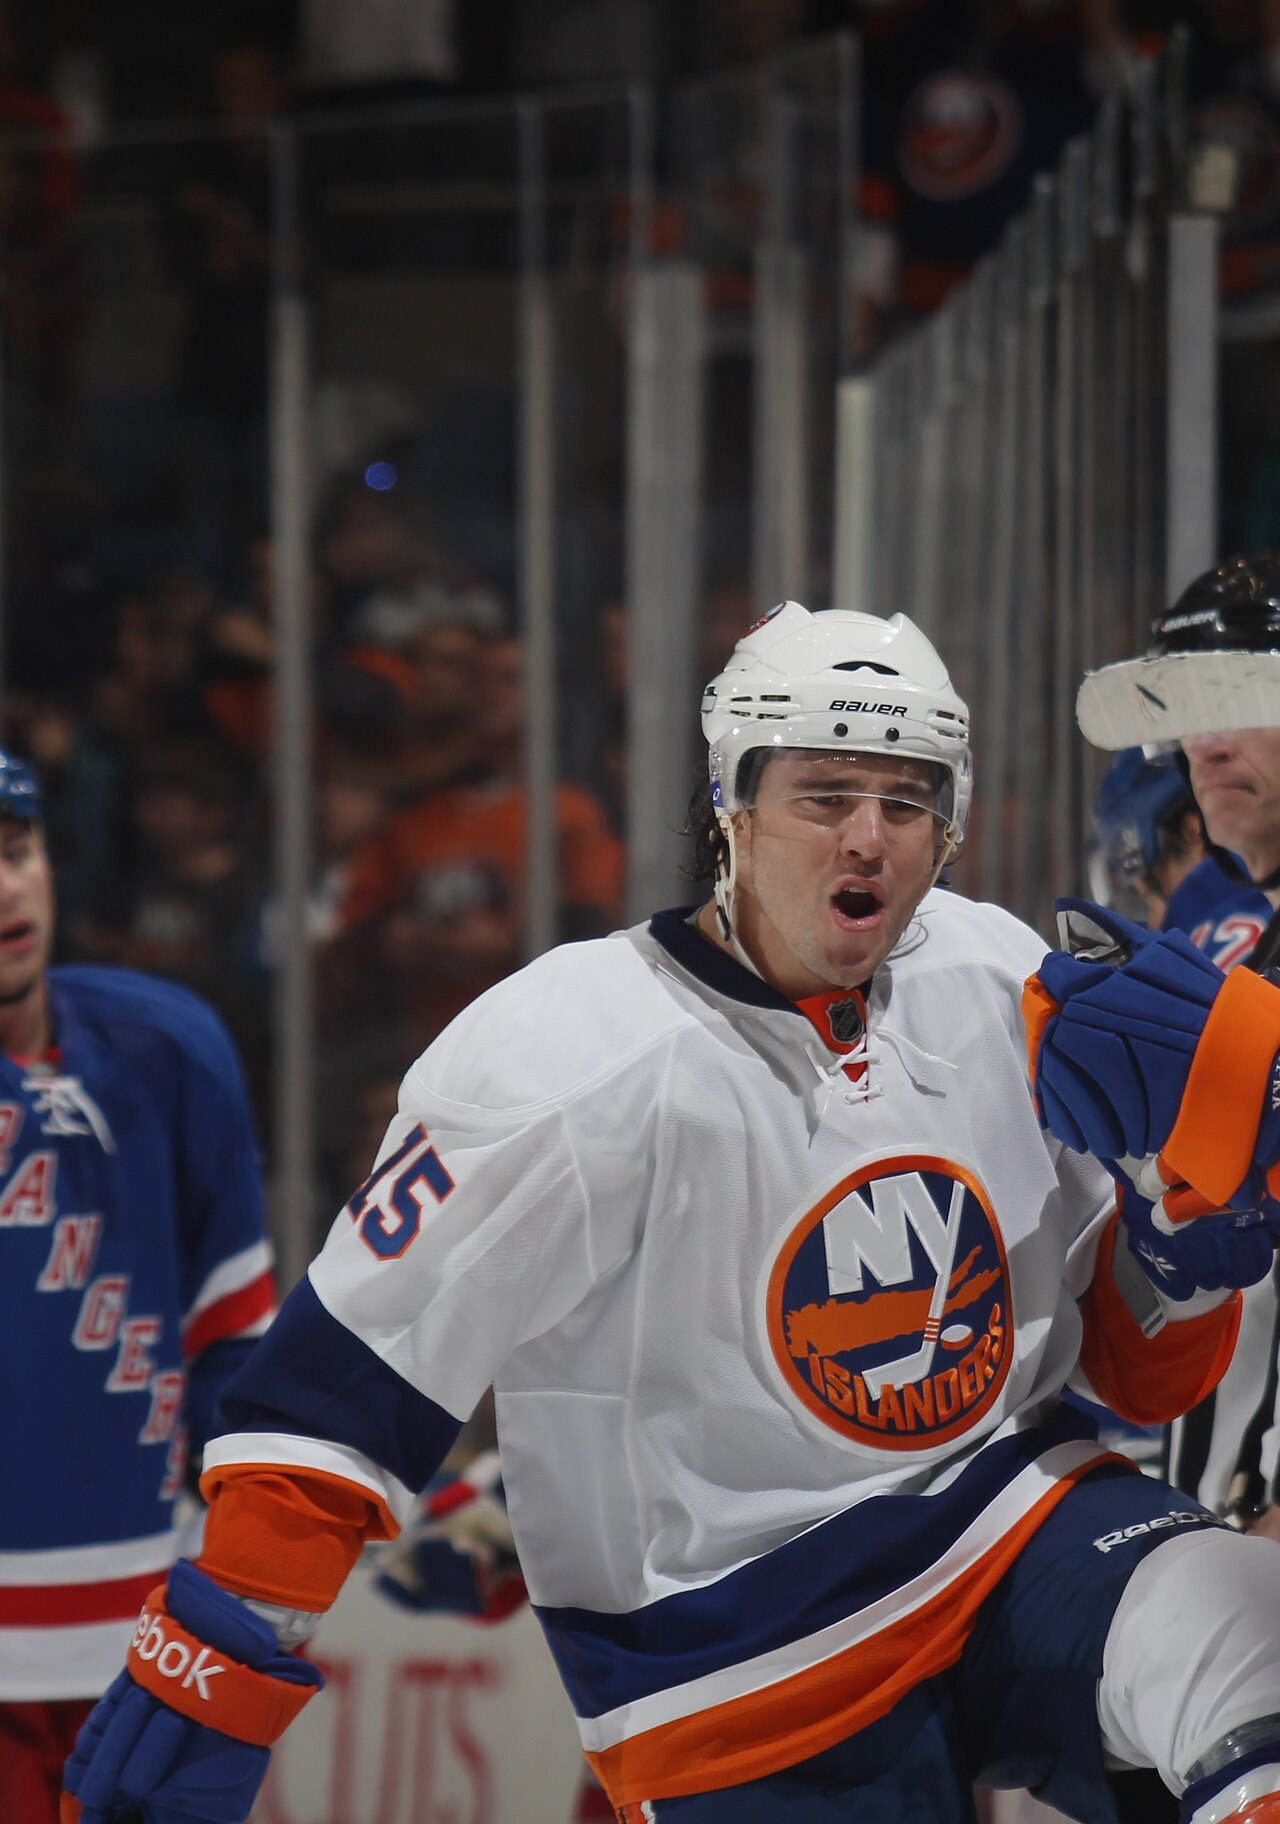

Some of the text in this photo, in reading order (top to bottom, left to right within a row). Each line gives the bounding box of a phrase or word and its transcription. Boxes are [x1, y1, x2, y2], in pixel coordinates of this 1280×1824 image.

[829, 700, 908, 718] BAUER
[346, 1121, 456, 1261] 15
[808, 1302, 1005, 1432] ISLANDERS
[131, 1603, 227, 1702] ebok
